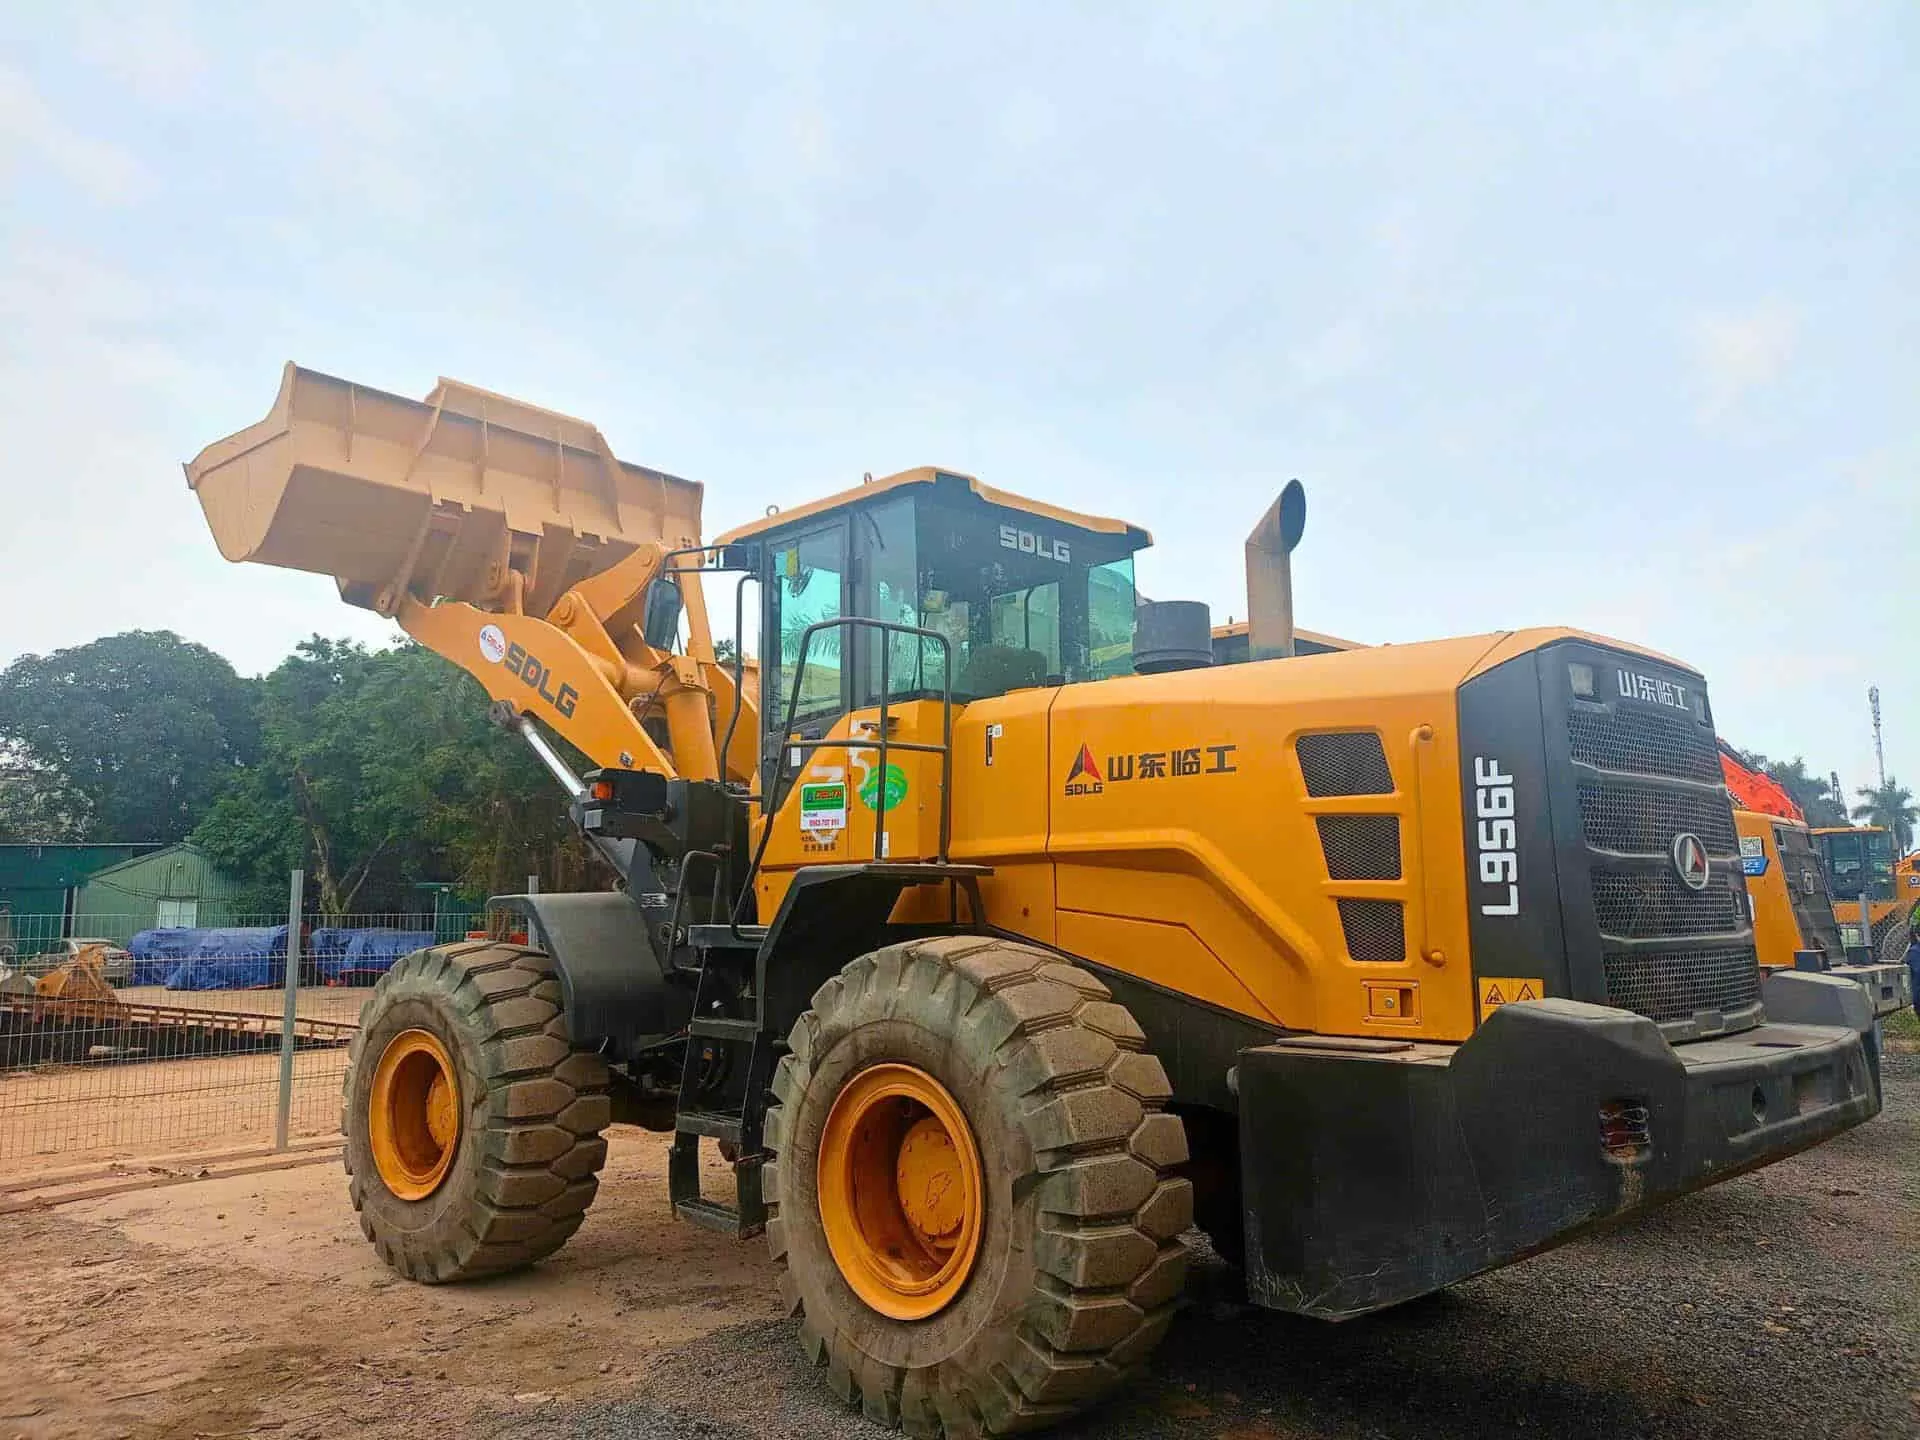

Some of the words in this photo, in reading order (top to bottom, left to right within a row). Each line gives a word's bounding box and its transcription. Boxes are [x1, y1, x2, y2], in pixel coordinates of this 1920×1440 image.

[999, 524, 1070, 563] SDLG
[503, 641, 579, 719] SDLG
[1616, 669, 1690, 710] 山东临工
[1107, 744, 1237, 782] 山东临工
[1064, 782, 1104, 796] SDLG
[1474, 756, 1519, 916] L956F
